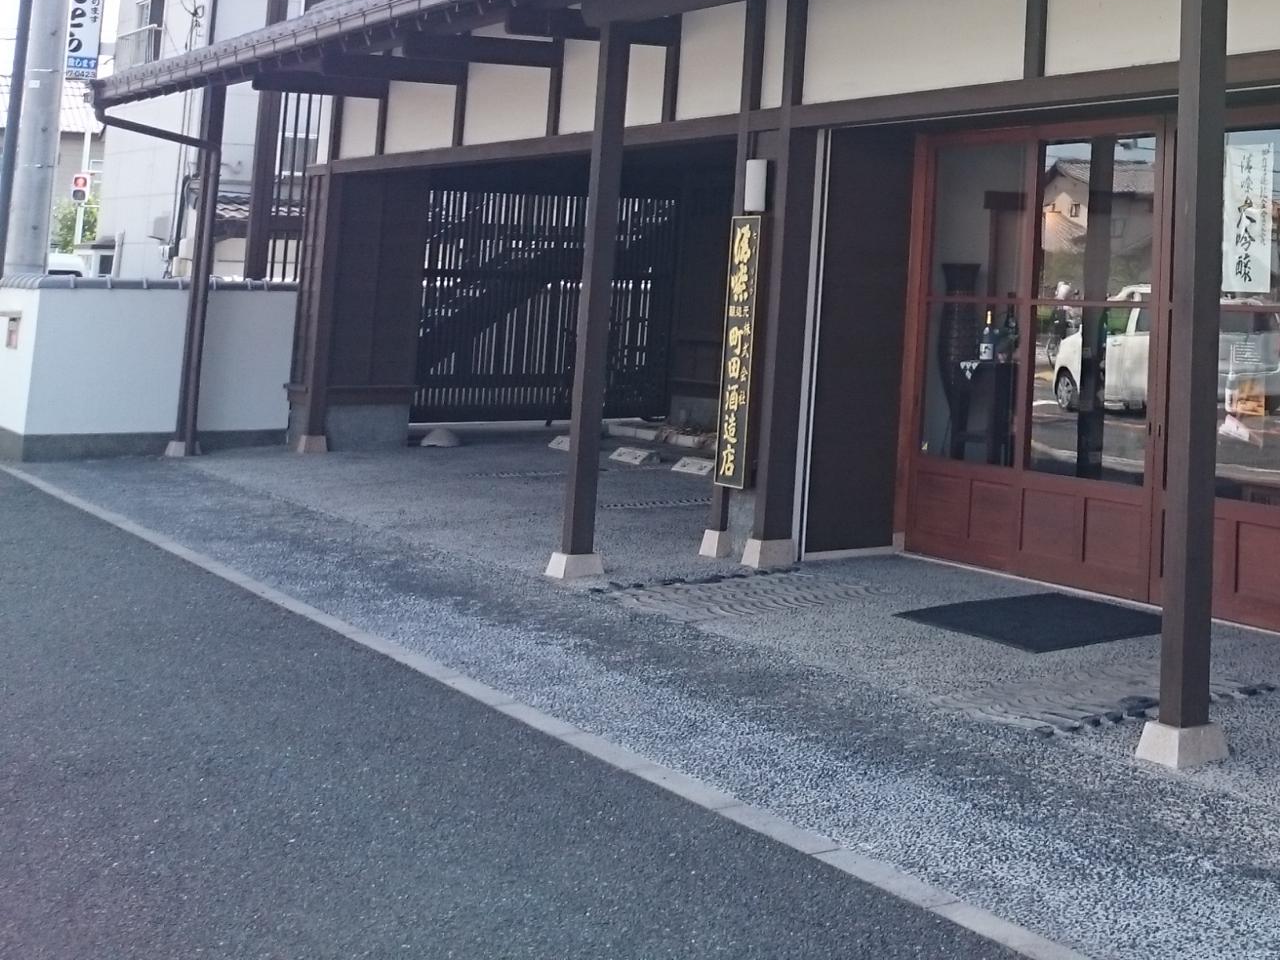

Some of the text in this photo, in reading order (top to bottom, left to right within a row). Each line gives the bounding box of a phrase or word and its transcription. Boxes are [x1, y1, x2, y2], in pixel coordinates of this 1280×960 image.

[719, 326, 744, 477] 町田酒造店
[738, 321, 752, 406] 株式会社
